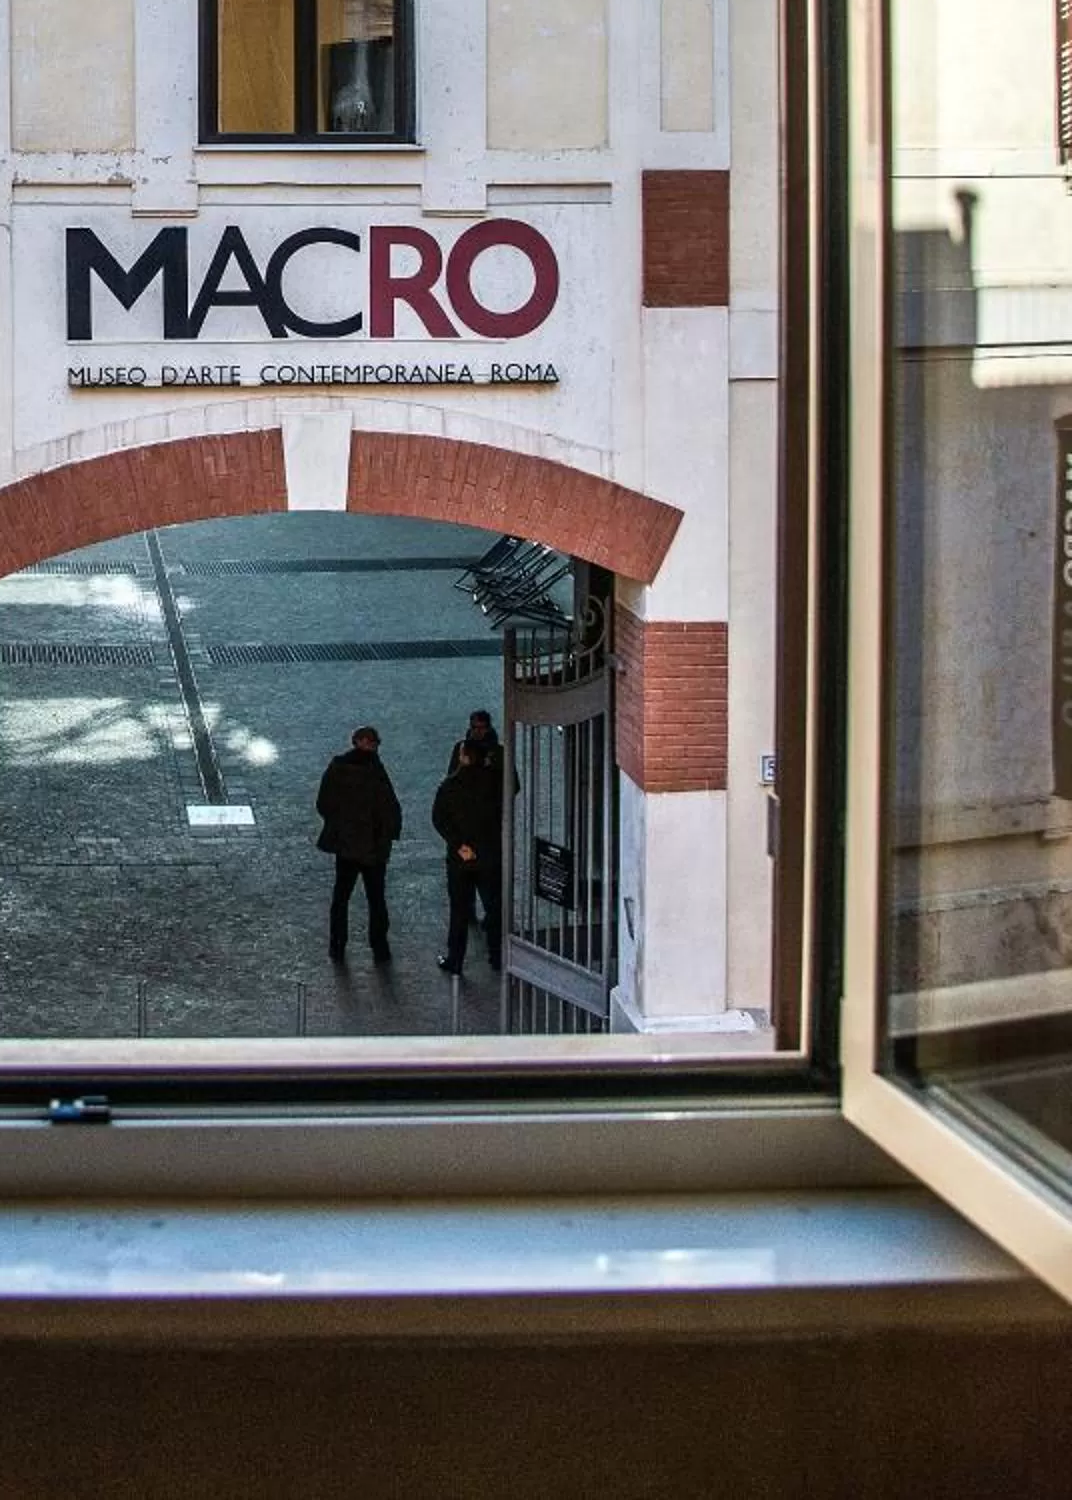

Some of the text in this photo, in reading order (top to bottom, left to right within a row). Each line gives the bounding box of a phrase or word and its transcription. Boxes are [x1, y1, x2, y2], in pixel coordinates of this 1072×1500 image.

[65, 217, 561, 340] MACRO
[68, 363, 560, 385] MUSEO D'ARTE CONTEMPORANEA ROMA
